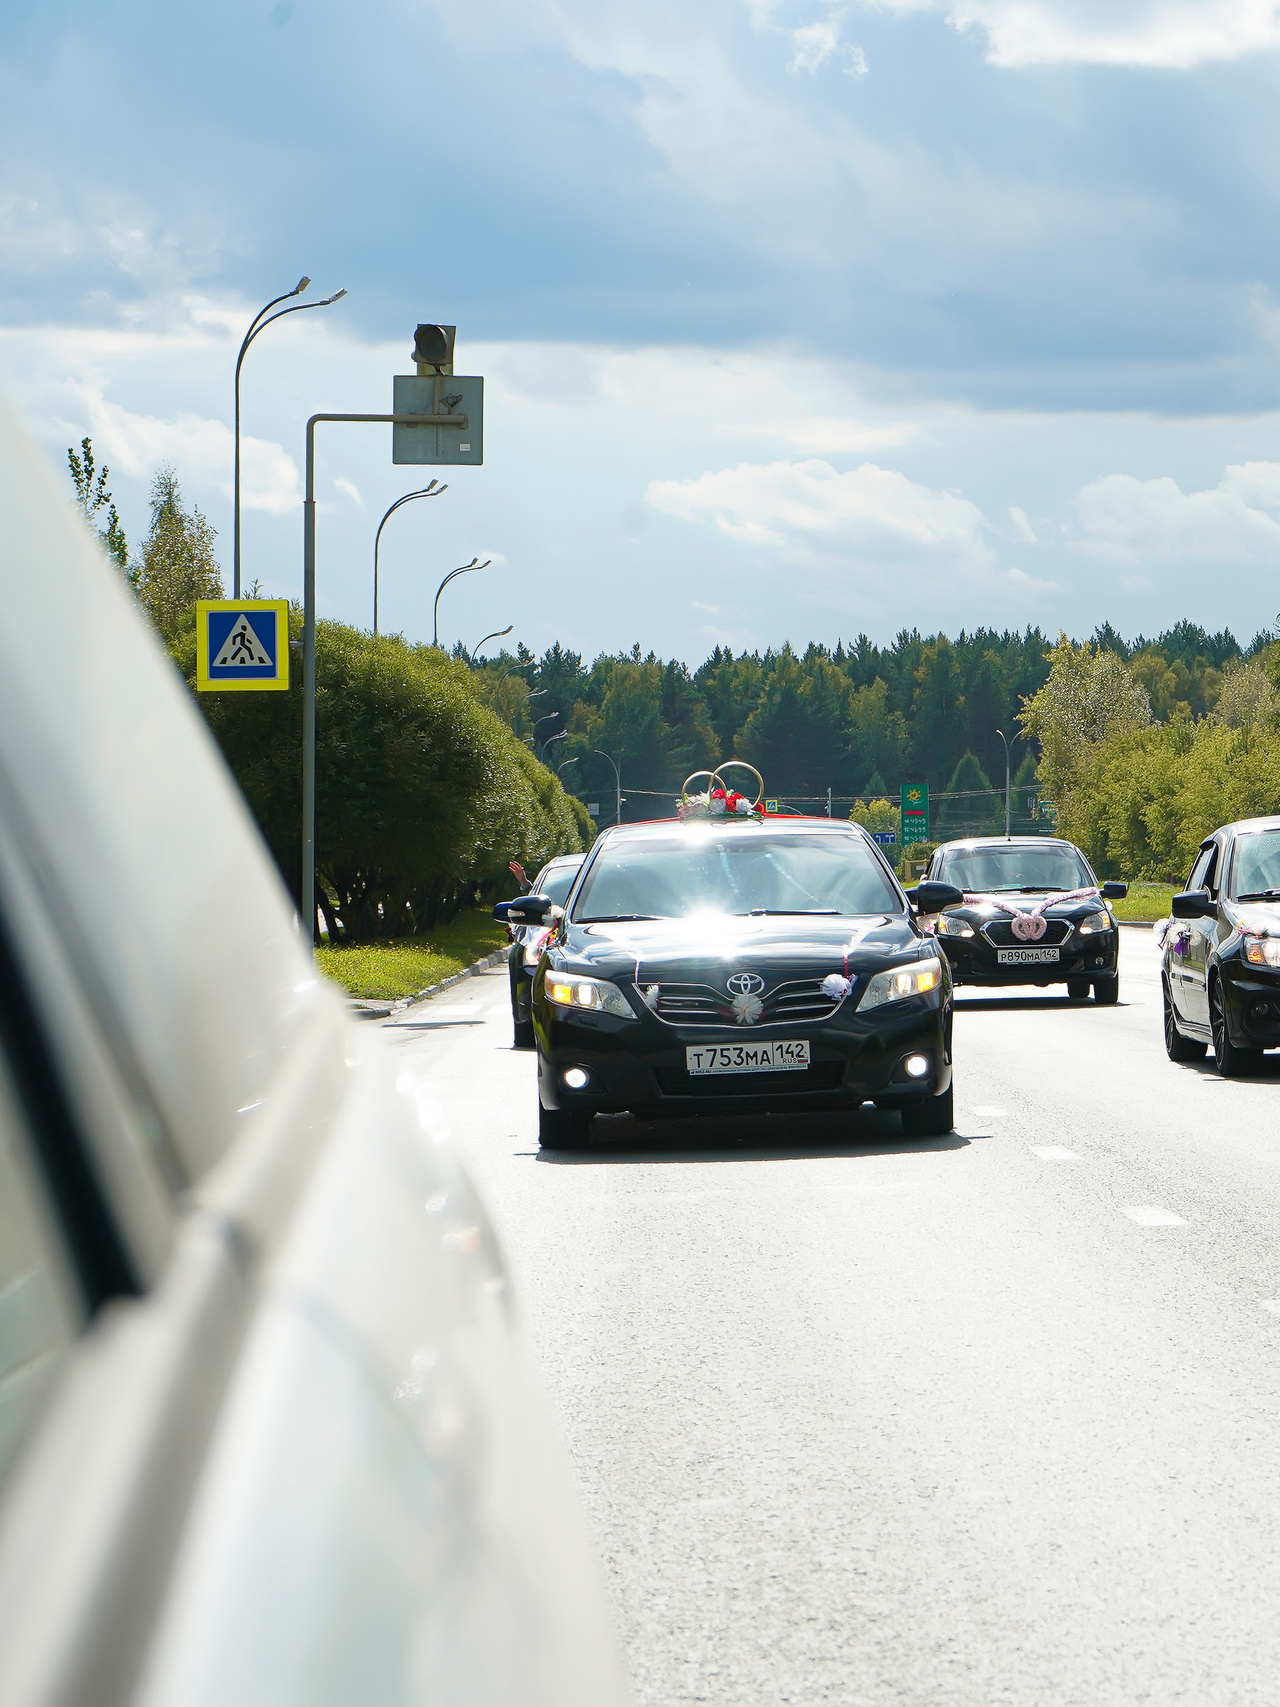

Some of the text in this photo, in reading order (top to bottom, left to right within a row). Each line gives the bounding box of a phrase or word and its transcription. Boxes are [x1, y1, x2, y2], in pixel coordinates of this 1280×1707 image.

[1001, 949, 1057, 962] Р890МА 142
[693, 1042, 805, 1068] Т753МА 142
